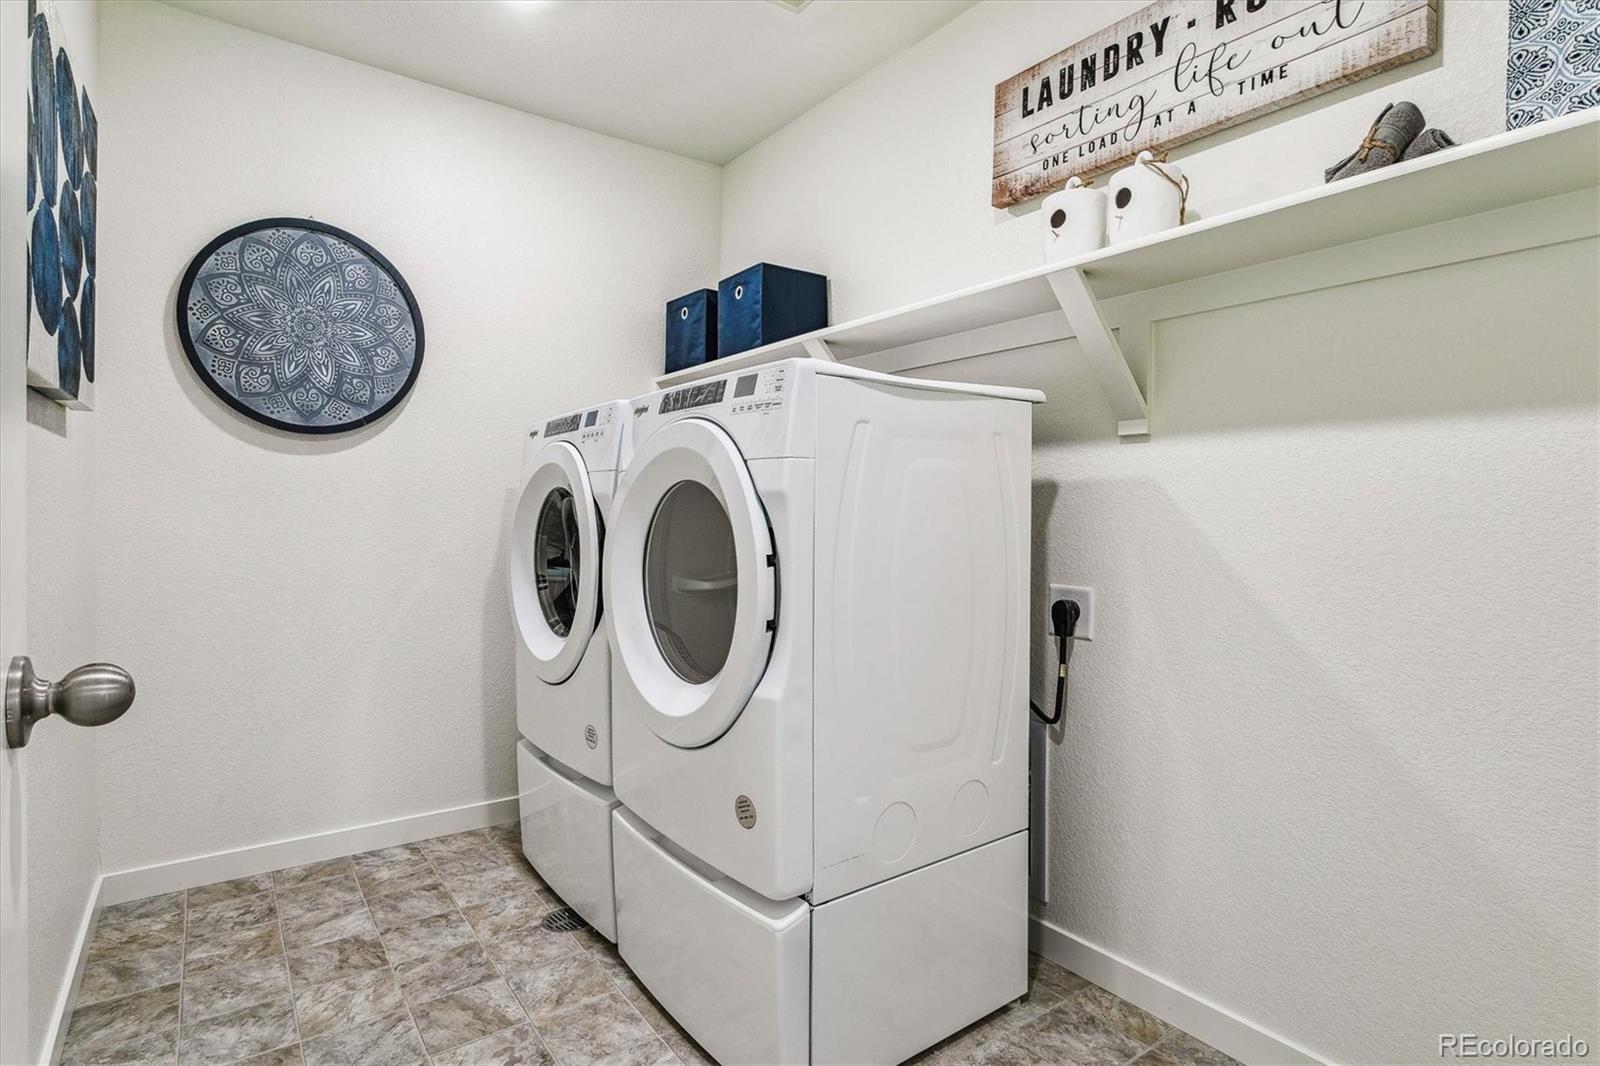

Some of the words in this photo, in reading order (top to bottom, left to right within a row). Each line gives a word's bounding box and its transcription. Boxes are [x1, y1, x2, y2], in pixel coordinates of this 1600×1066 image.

[1021, 16, 1170, 119] LAUNDRY
[1029, 89, 1157, 155] sorting
[1174, 42, 1251, 97] life
[1042, 150, 1068, 171] ONE
[1079, 132, 1118, 157] LOAD
[1153, 108, 1175, 128] AT
[1187, 101, 1196, 115] A
[1237, 63, 1289, 95] TIME
